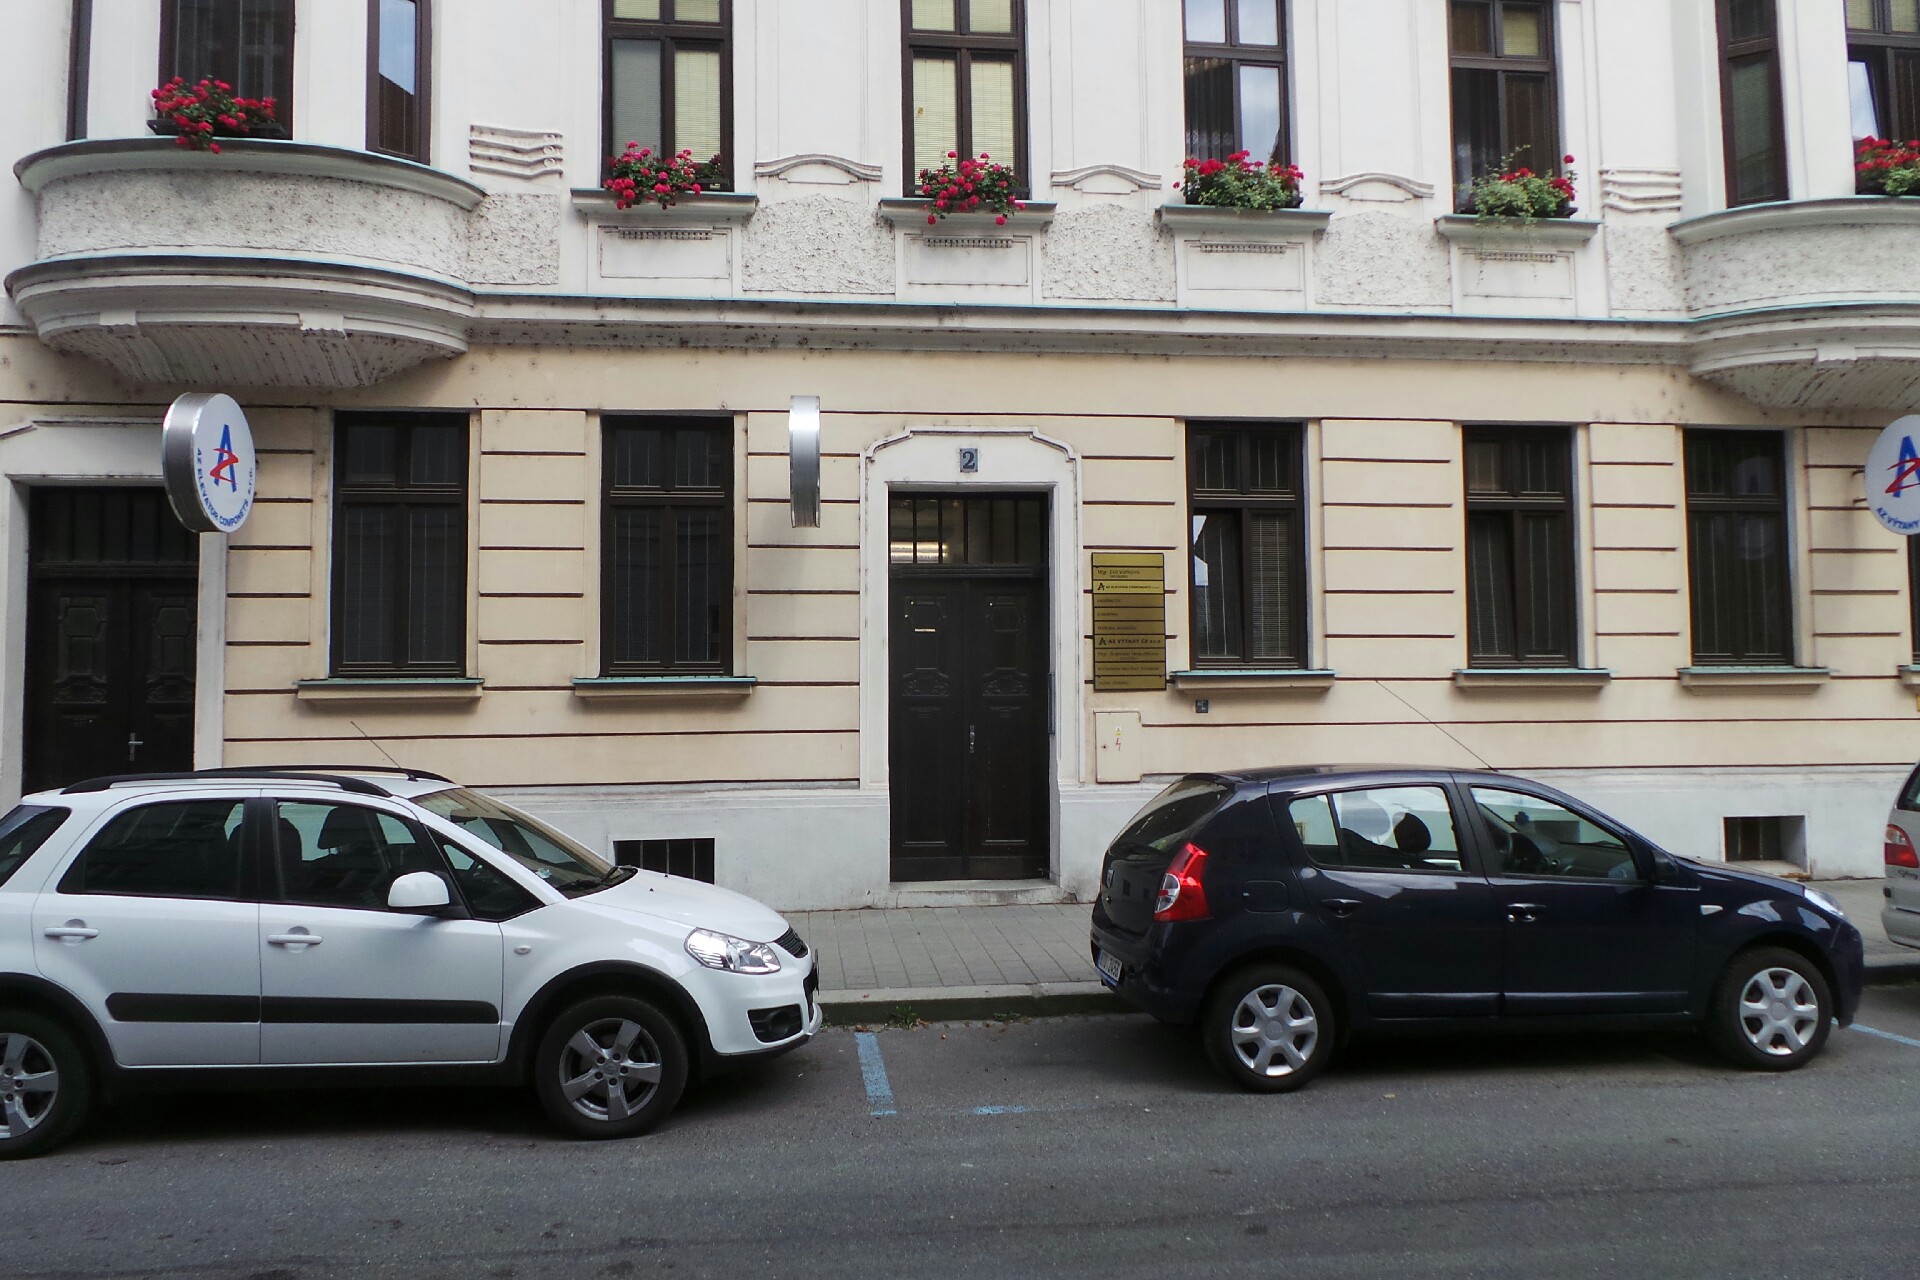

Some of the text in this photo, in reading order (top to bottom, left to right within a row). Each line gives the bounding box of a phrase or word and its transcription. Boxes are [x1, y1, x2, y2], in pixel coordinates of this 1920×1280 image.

[962, 451, 975, 469] 2
[197, 468, 219, 520] ELEVATOR
[1876, 507, 1888, 519] AZ
